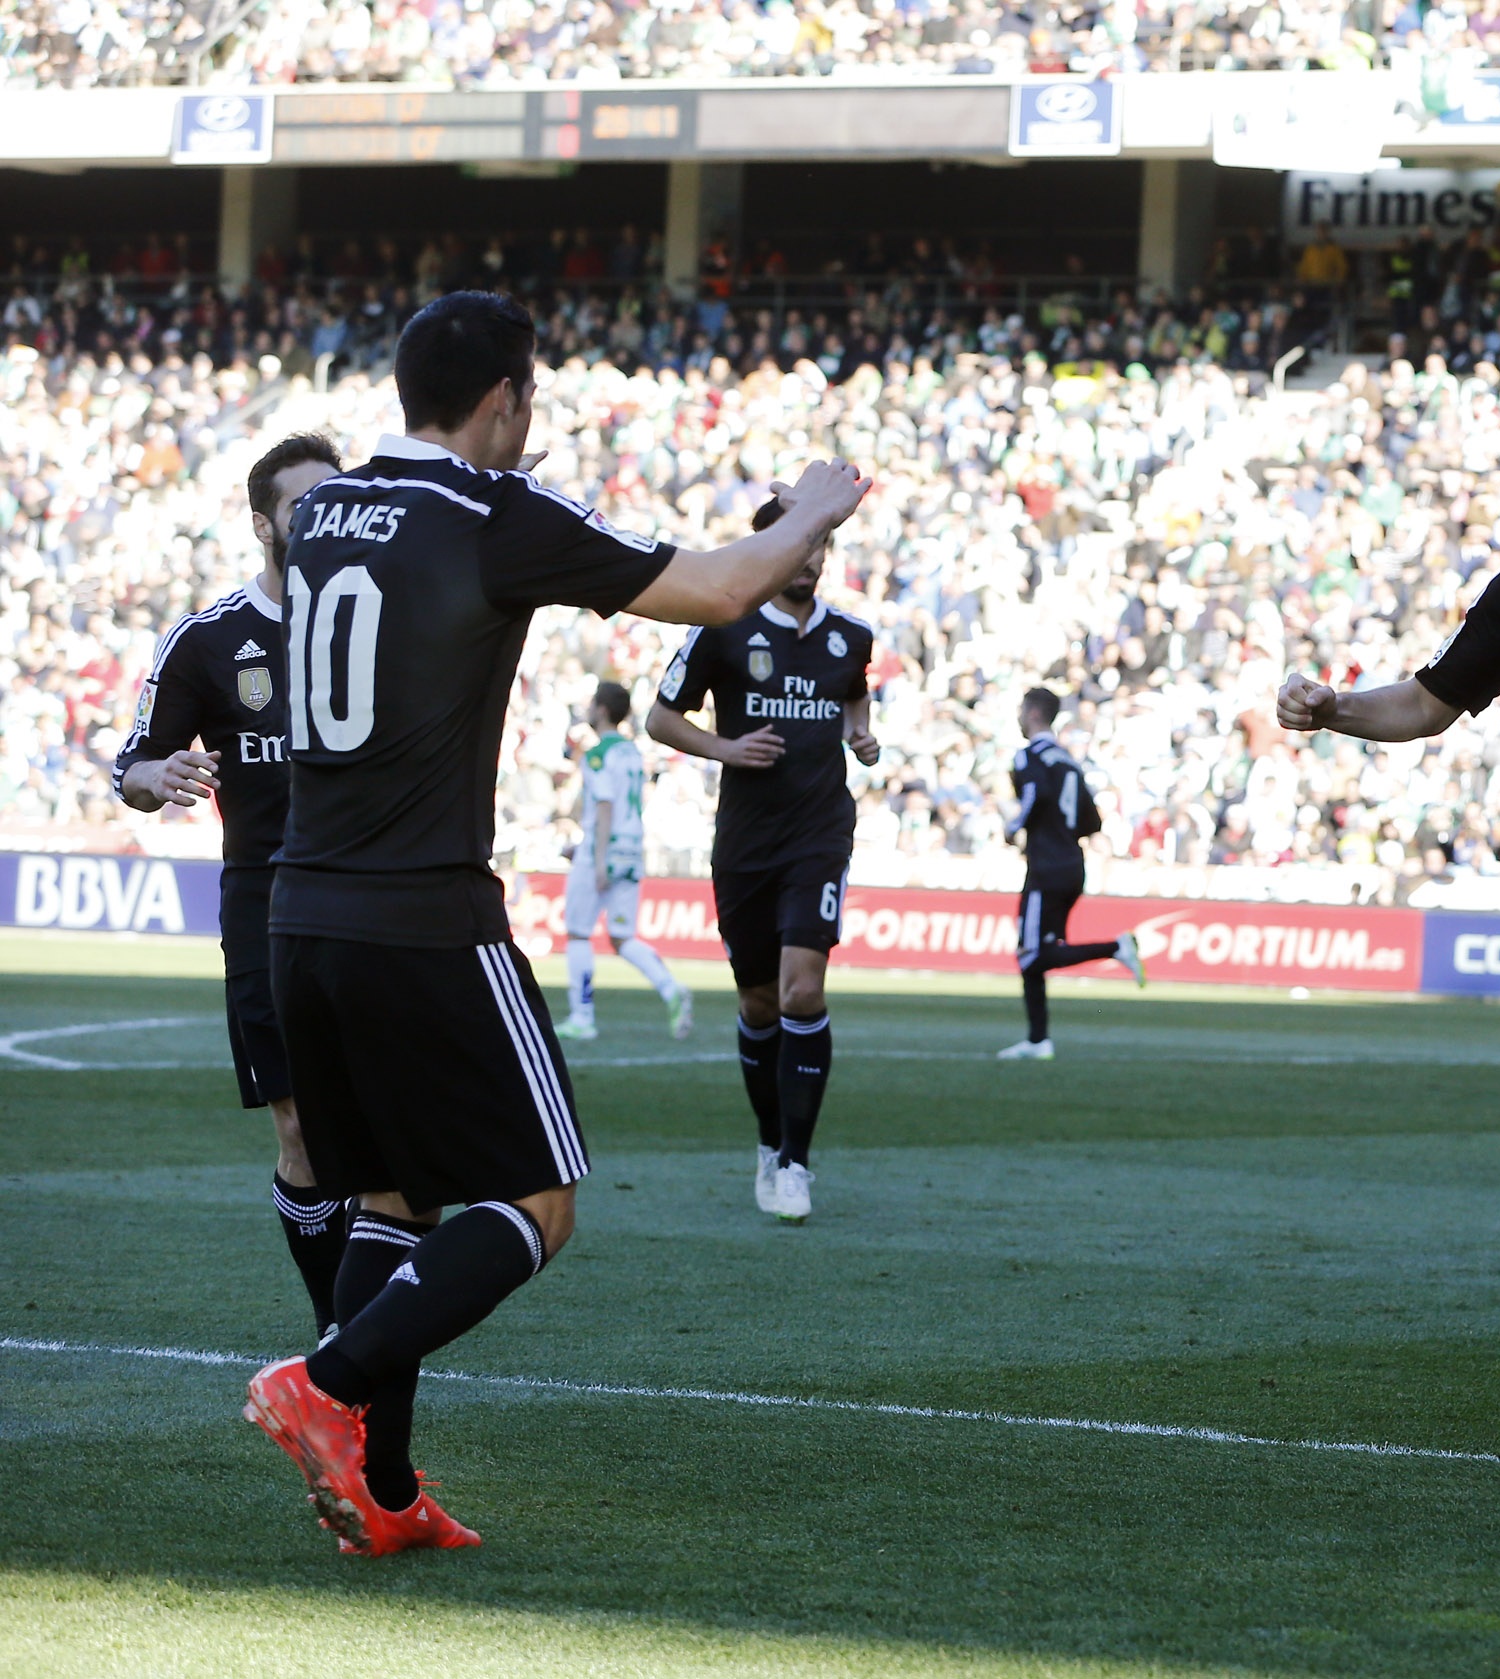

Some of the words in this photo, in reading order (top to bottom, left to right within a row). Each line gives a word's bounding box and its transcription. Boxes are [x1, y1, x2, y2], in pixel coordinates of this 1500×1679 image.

[303, 502, 407, 543] JAMES
[234, 649, 267, 661] adidas
[287, 565, 383, 752] 10
[784, 676, 816, 698] Fly
[15, 855, 186, 933] BBVA
[820, 881, 838, 922] 6
[300, 1221, 328, 1236] RM
